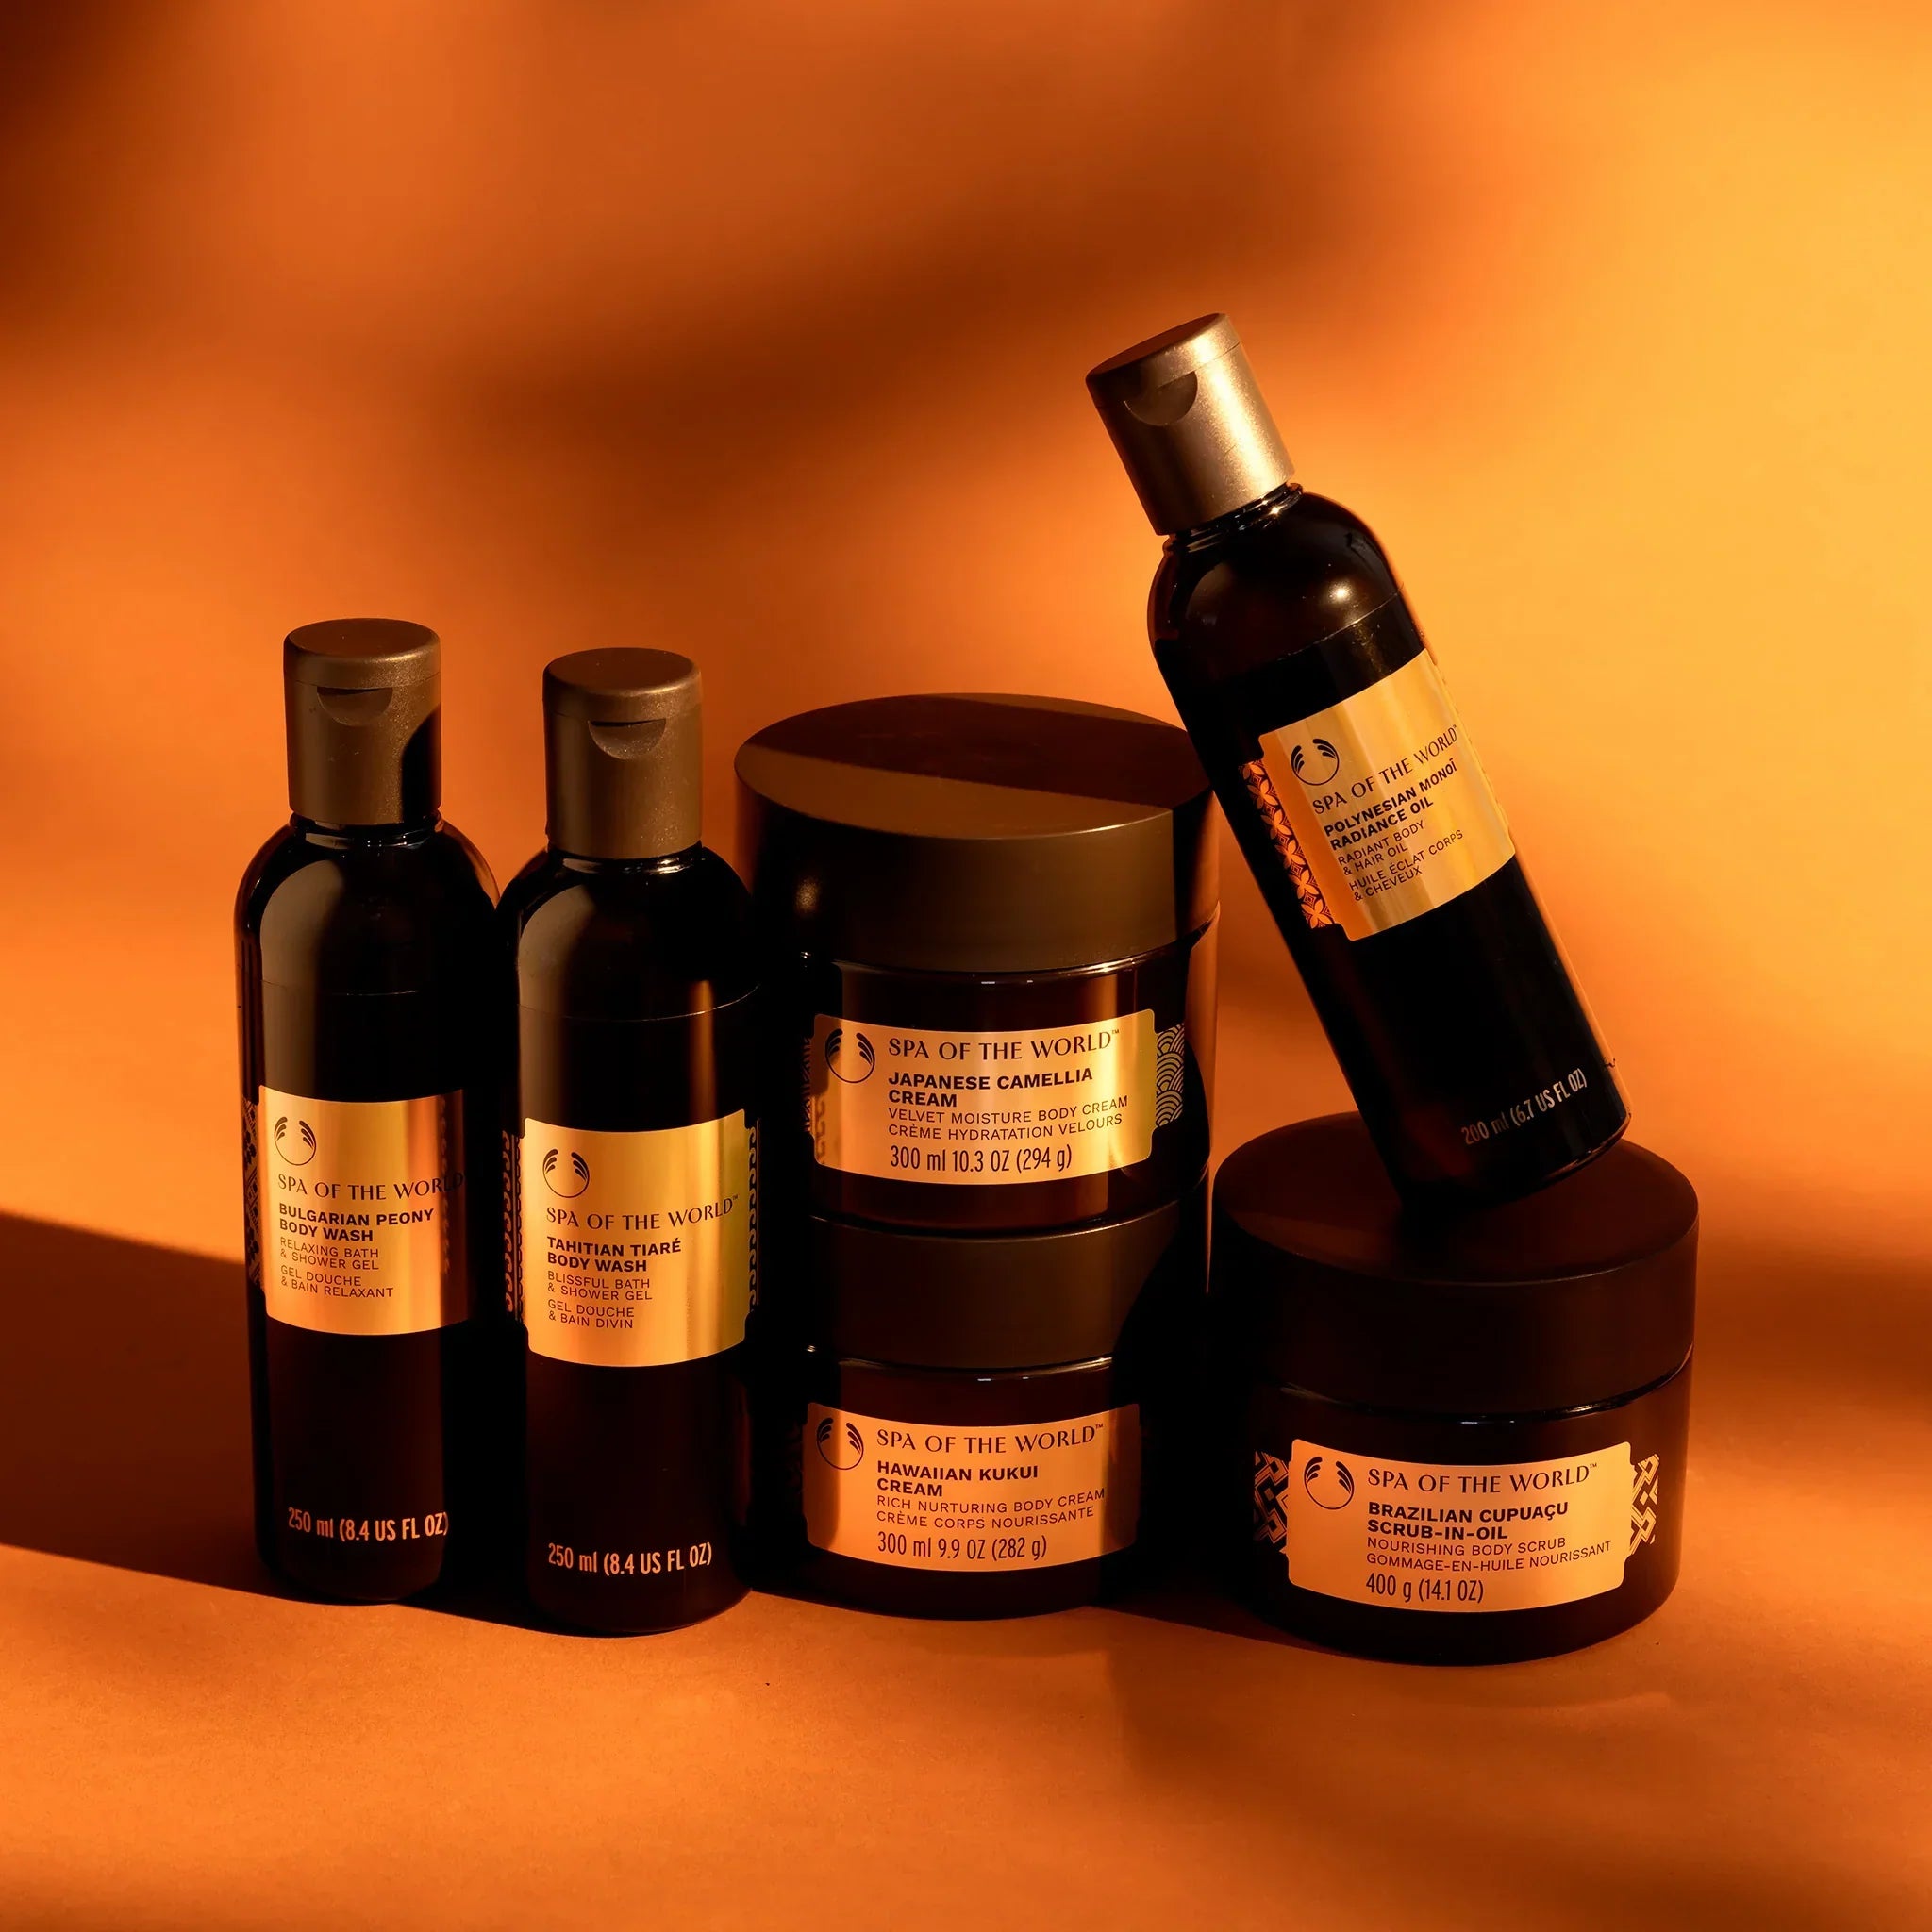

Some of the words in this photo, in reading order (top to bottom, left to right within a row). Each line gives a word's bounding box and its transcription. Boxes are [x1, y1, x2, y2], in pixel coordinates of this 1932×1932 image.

[1313, 792, 1347, 815] SPA
[1351, 776, 1375, 798] OF
[1379, 758, 1413, 784] THE
[1324, 787, 1417, 837] POLYNESIAN
[1419, 758, 1457, 792] MONOÏ
[1330, 808, 1407, 851] RADIANCE
[1410, 796, 1434, 815] OIL
[1338, 838, 1390, 866] RADIANT
[1393, 821, 1424, 841] BODY
[1343, 866, 1350, 875] &
[1355, 854, 1383, 872] HAIR
[1387, 844, 1408, 858] OIL
[1349, 872, 1387, 891] HUILE
[1389, 851, 1425, 874] ÉCLAT
[1428, 830, 1463, 855] CORPS
[1355, 891, 1362, 901] &
[1365, 866, 1423, 896] CHEVEUX
[888, 1038, 929, 1058] SPA
[939, 1042, 971, 1060] OF
[979, 1041, 1023, 1060] THE
[888, 1072, 991, 1090] JAPANESE
[997, 1068, 1093, 1089] CAMELLIA
[888, 1091, 958, 1108] CREAM
[888, 1108, 944, 1124] VELVET
[951, 1111, 1031, 1124] MOISTURE
[1038, 1107, 1077, 1122] BODY
[1081, 1094, 1128, 1116] CREAM
[1462, 1121, 1489, 1145] 200
[1491, 1112, 1509, 1134] ml
[1510, 1099, 1535, 1126] (6.7
[1535, 1090, 1556, 1112] US
[1553, 1081, 1570, 1102] FL
[1568, 1068, 1587, 1092] OZ)
[888, 1123, 941, 1140] CRÈME
[948, 1124, 1053, 1141] HYDRATATION
[1058, 1113, 1123, 1135] VELOURS
[890, 1145, 920, 1170] 300
[926, 1150, 946, 1171] ml
[952, 1150, 983, 1173] 10.3
[991, 1150, 1009, 1173] OZ
[1016, 1148, 1051, 1174] (294
[1057, 1144, 1073, 1172] g)
[278, 1174, 307, 1194] SPA
[314, 1182, 341, 1198] OF
[347, 1184, 386, 1200] THE
[279, 1203, 370, 1225] BULGARIAN
[376, 1208, 434, 1225] PEONY
[546, 1208, 579, 1227] SPA
[587, 1213, 614, 1230] OF
[623, 1213, 660, 1230] THE
[279, 1219, 318, 1237] BODY
[323, 1228, 373, 1241] WASH
[280, 1237, 339, 1257] RELAXING
[345, 1248, 378, 1257] BATH
[547, 1237, 624, 1256] TAHITIAN
[630, 1238, 681, 1256] TIARÉ
[281, 1249, 287, 1257] &
[291, 1252, 346, 1269] SHOWER
[353, 1259, 379, 1270] GEL
[547, 1253, 590, 1270] BODY
[595, 1260, 647, 1272] WASH
[281, 1265, 302, 1279] GEL
[307, 1271, 361, 1286] DOUCHE
[548, 1271, 608, 1289] BLISSFUL
[615, 1278, 650, 1289] BATH
[281, 1277, 288, 1286] &
[291, 1280, 318, 1293] BAIN
[324, 1286, 393, 1297] RELAXANT
[548, 1283, 555, 1291] &
[561, 1286, 619, 1300] SHOWER
[625, 1291, 652, 1300] GEL
[548, 1299, 571, 1312] GEL
[576, 1305, 635, 1317] DOUCHE
[549, 1311, 556, 1321] &
[560, 1313, 590, 1326] BAIN
[595, 1317, 633, 1329] DIVIN
[876, 1429, 916, 1450] SPA
[925, 1435, 956, 1453] OF
[964, 1436, 1007, 1454] THE
[877, 1460, 972, 1481] HAWAIIAN
[979, 1465, 1039, 1482] KUKUI
[1368, 1468, 1409, 1491] SPA
[1418, 1474, 1450, 1493] OF
[1458, 1476, 1501, 1493] THE
[876, 1478, 943, 1497] CREAM
[877, 1494, 911, 1510] RICH
[918, 1501, 1008, 1513] NURTURING
[1013, 1498, 1053, 1511] BODY
[1058, 1488, 1105, 1507] CREAM
[876, 1510, 927, 1527] CRÈME
[934, 1517, 985, 1529] CORPS
[991, 1506, 1094, 1529] NOURISSANTE
[1369, 1502, 1472, 1523] BRAZILIAN
[1479, 1502, 1569, 1522] CUPUAÇU
[289, 1507, 311, 1533] 250
[316, 1519, 334, 1539] ml
[339, 1518, 370, 1542] (8.4
[375, 1518, 396, 1541] US
[402, 1518, 420, 1539] FL
[425, 1511, 449, 1537] OZ)
[1367, 1520, 1508, 1539] SCRUB-IN-OIL
[877, 1531, 907, 1555] 300
[913, 1537, 931, 1557] ml
[938, 1538, 960, 1558] 9.9
[967, 1539, 986, 1559] OZ
[991, 1538, 1024, 1561] (282
[1032, 1535, 1047, 1560] g)
[1366, 1553, 1524, 1572] GOMMAGE-EN-HUILE
[1529, 1541, 1612, 1568] NOURISSANT
[1367, 1537, 1465, 1556] NOURISHING
[1472, 1541, 1512, 1556] BODY
[1518, 1538, 1566, 1553] SCRUB
[548, 1543, 574, 1569] 250
[579, 1551, 597, 1574] ml
[604, 1553, 635, 1576] (8.4
[641, 1553, 661, 1574] US
[667, 1550, 684, 1572] FL
[690, 1541, 712, 1568] OZ)
[1366, 1573, 1396, 1596] 400
[1403, 1579, 1412, 1602] g
[1418, 1578, 1451, 1602] (14.1
[1457, 1579, 1484, 1603] OZ)
